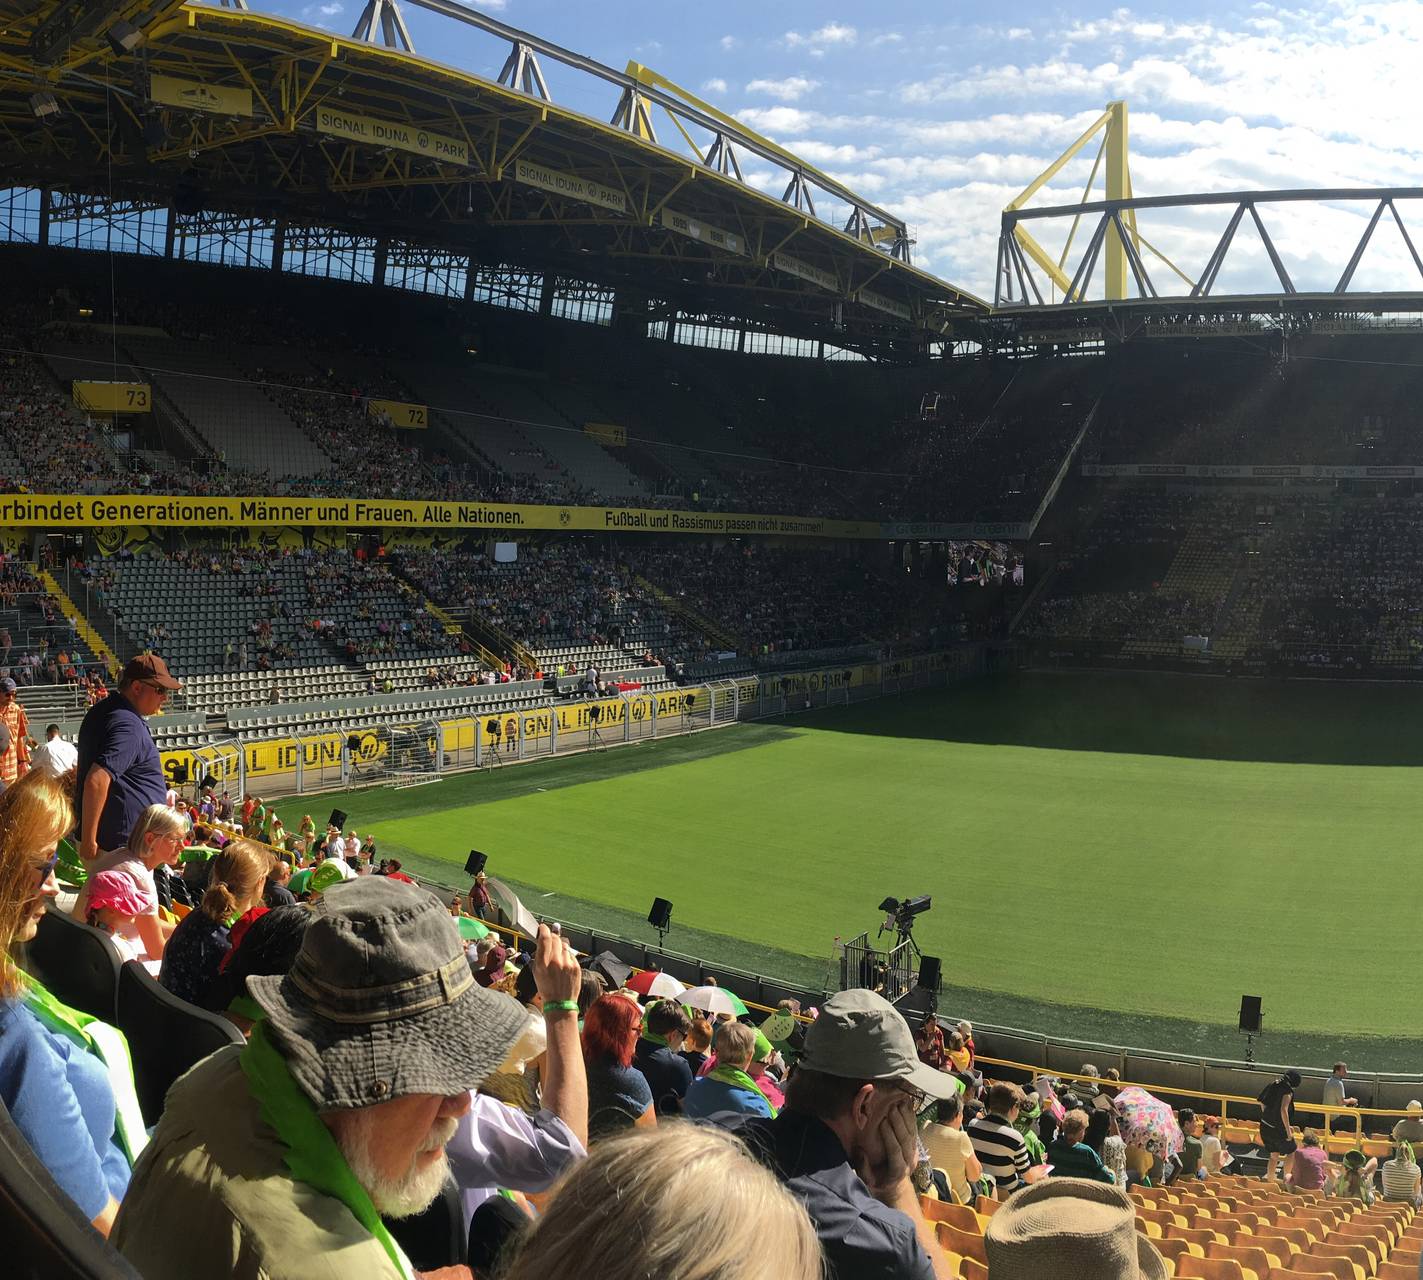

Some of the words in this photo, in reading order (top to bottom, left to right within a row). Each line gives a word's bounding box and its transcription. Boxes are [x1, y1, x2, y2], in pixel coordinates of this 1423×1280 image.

[321, 113, 367, 136] SIGNAL
[372, 125, 410, 145] IDUNA
[435, 140, 466, 159] PARK
[519, 165, 552, 186] SIGNAL
[555, 176, 583, 194] IDUNA
[600, 190, 624, 207] PARK
[126, 391, 147, 406] 73
[408, 409, 425, 424] 72
[0, 500, 84, 521] rbindet
[91, 501, 235, 521] Generationen.
[240, 501, 312, 521] Männer
[317, 503, 349, 521] und
[355, 504, 418, 523] Frauen.
[422, 506, 452, 523] Alle
[458, 507, 525, 525] Nationen.
[605, 511, 648, 527] Fußball
[650, 513, 669, 528] und
[672, 514, 724, 530] Rassismus
[726, 518, 755, 533] passen
[758, 518, 778, 532] nicht
[780, 519, 825, 534] zusammen!
[517, 710, 571, 738] GNAL
